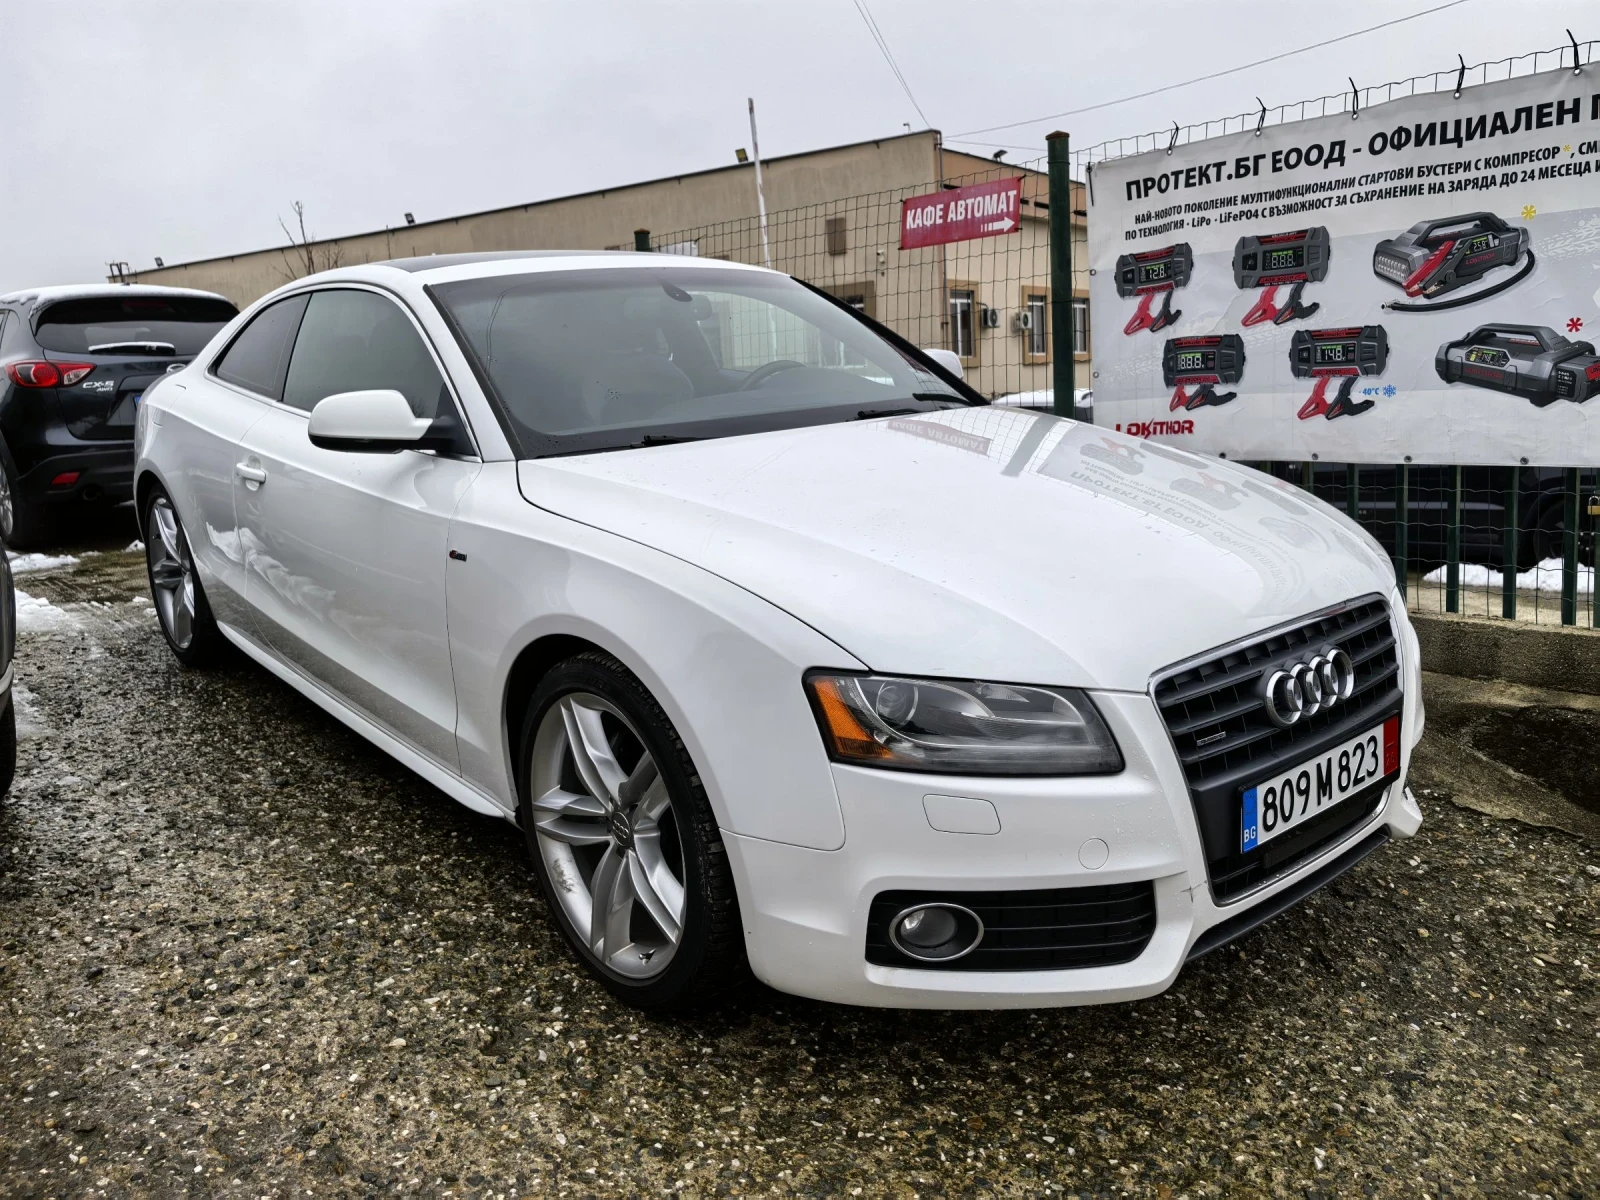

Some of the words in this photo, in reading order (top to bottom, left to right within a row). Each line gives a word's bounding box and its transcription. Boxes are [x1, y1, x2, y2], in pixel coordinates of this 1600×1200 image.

[1126, 154, 1266, 201] ПРОТЕКТ.БГ
[1271, 140, 1346, 173] ЕООД
[1368, 97, 1581, 156] ОФИЦИАЛЕН
[906, 203, 945, 230] КАФЕ
[947, 190, 1018, 223] АВТОМАТ
[1125, 230, 1137, 241] ПО
[1138, 219, 1185, 239] ТЕХНОЛОГИЯ
[1191, 216, 1211, 228] LiPo
[1269, 196, 1334, 218] ВЪЗМОЖНОСТ
[1334, 194, 1347, 207] ЗА
[1349, 184, 1425, 204] СЪХРАНЕНИЕ
[1427, 182, 1446, 195] НА
[1448, 175, 1497, 192] ЗАРЯДА
[1499, 172, 1518, 189] ДО
[1520, 169, 1535, 183] 24
[1538, 161, 1592, 181] МЕСЕЦА
[1135, 204, 1183, 225] НАЙ-НОВОТО
[1184, 195, 1239, 214] ПОКОЛЕНИЕ
[1240, 176, 1356, 205] МУЛТИФУНКЦИОНАЛНИ
[1358, 167, 1414, 187] СТАРТОВИ
[1417, 160, 1472, 178] БУСТЕРИ
[1484, 146, 1561, 170] КОМПРЕСОР
[1578, 140, 1600, 155] СМ
[82, 380, 114, 389] CX-5
[1243, 825, 1257, 843] BG
